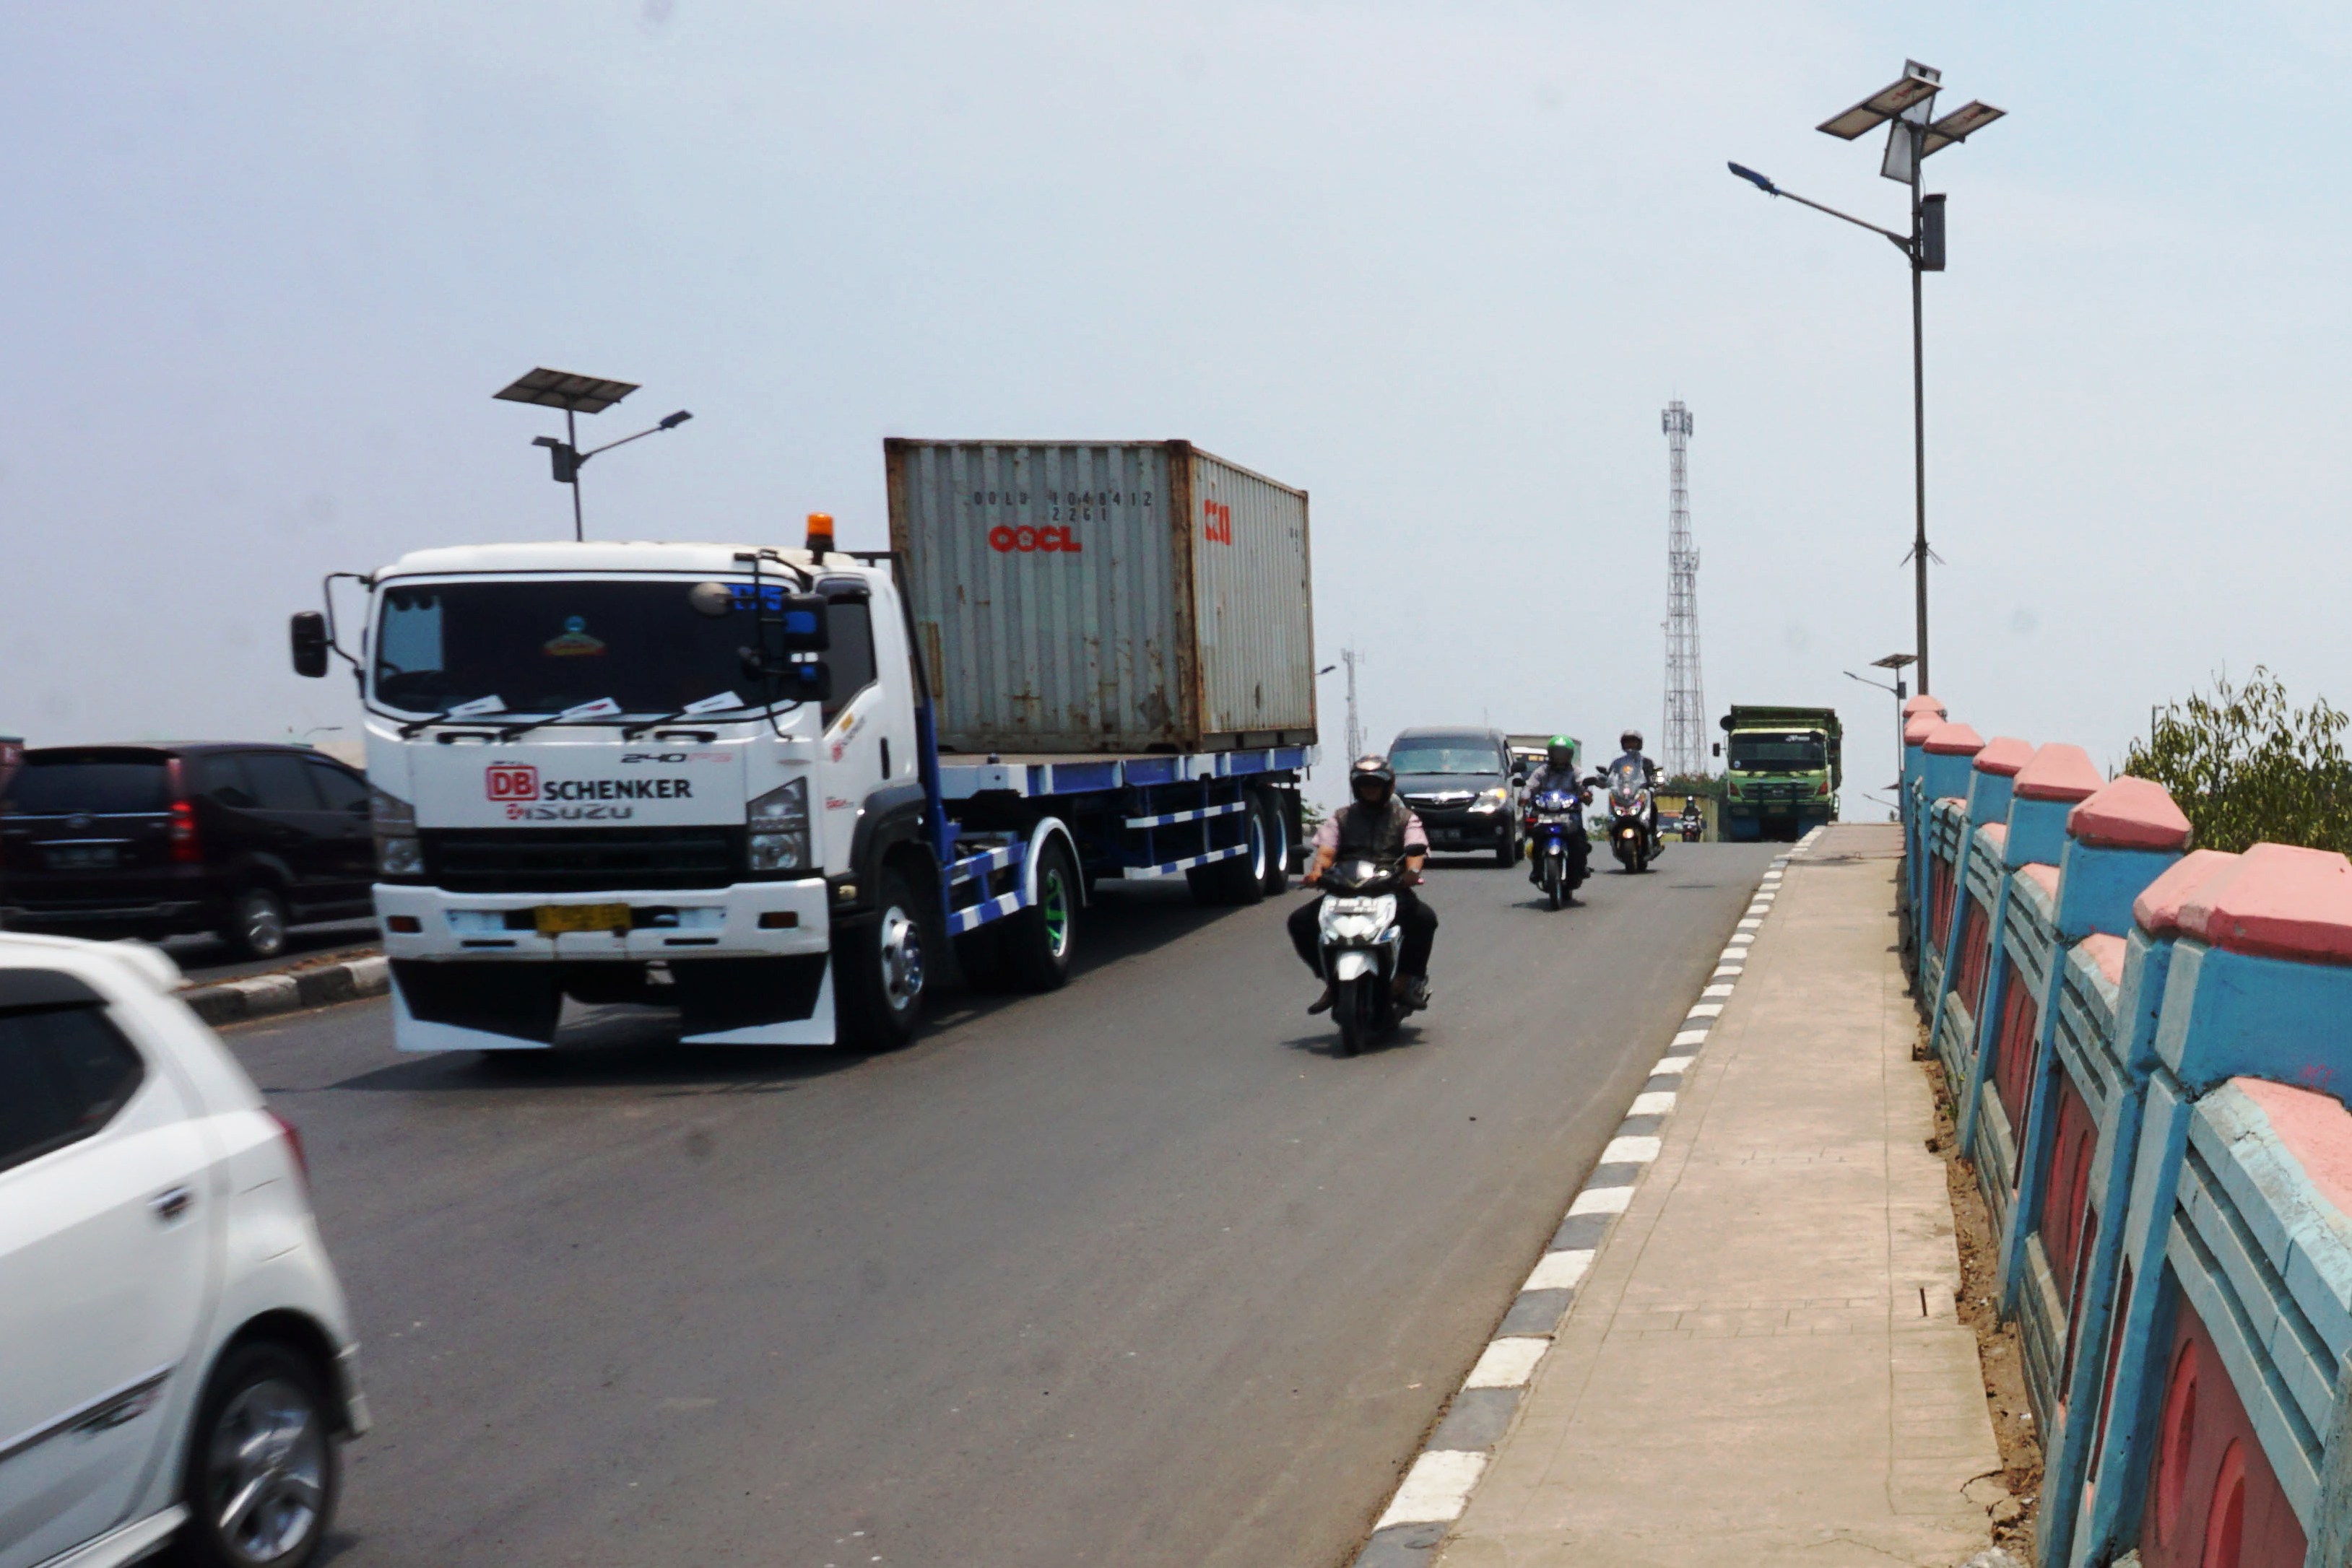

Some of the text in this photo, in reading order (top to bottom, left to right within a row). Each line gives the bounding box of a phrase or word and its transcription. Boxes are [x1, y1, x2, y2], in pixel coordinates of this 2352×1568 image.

[1052, 507, 1106, 521] 2261
[989, 525, 1082, 552] OOCL
[491, 772, 693, 801] DB SCHENKER
[524, 804, 634, 820] ISUZU
